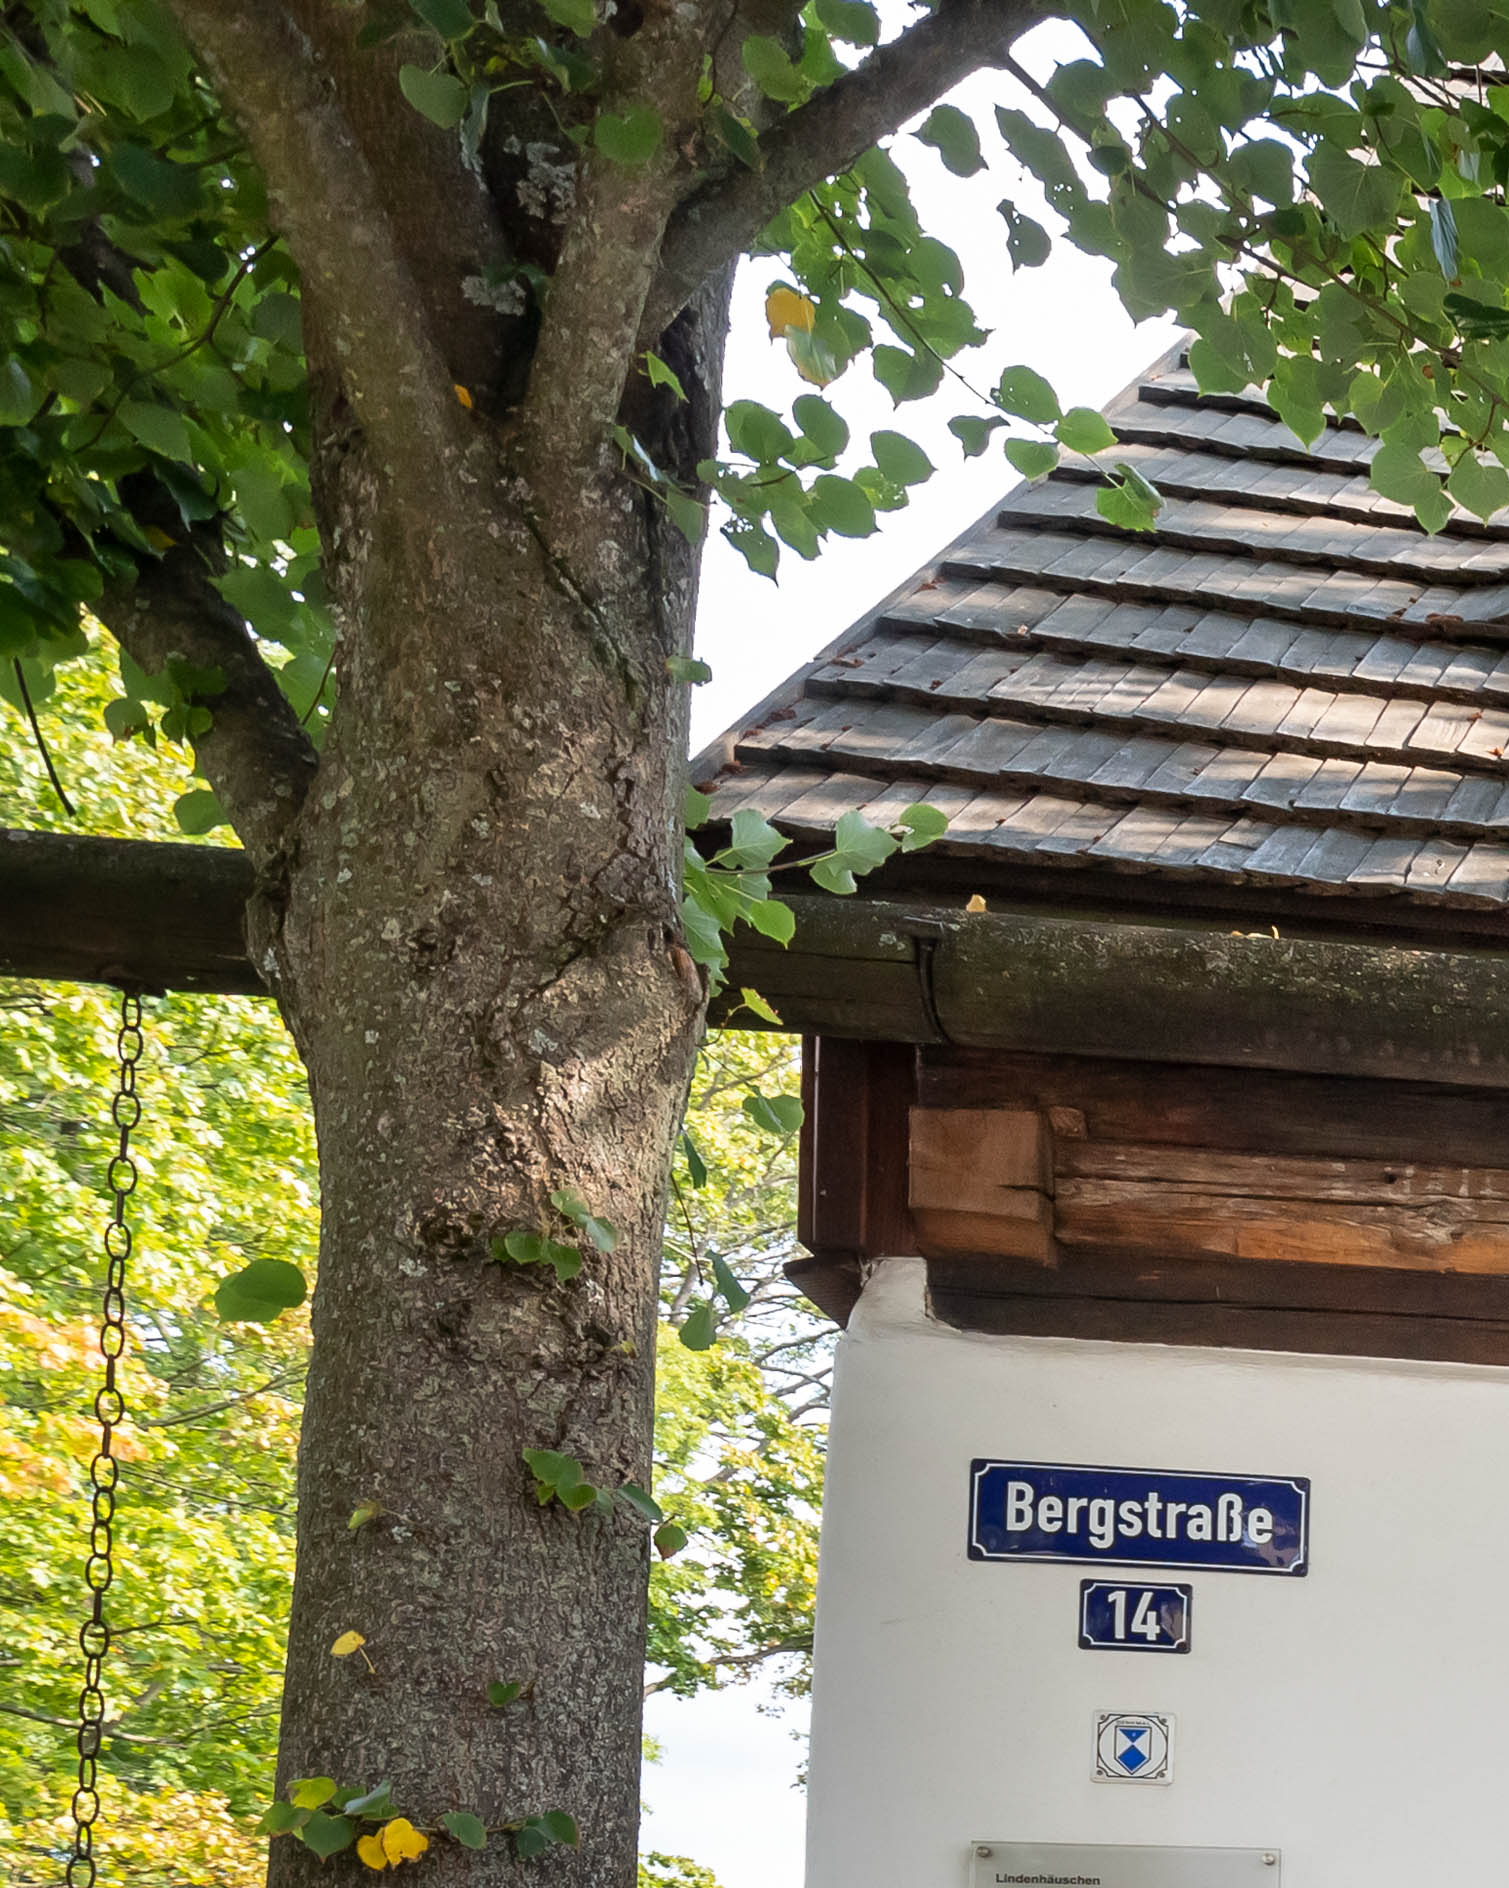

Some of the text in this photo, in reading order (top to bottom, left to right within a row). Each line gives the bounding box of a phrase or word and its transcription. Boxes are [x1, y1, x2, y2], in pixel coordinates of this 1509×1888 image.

[1006, 1481, 1273, 1549] Bergstraße
[1107, 1590, 1160, 1641] 14
[995, 1873, 1101, 1885] Lindenhäuschen
